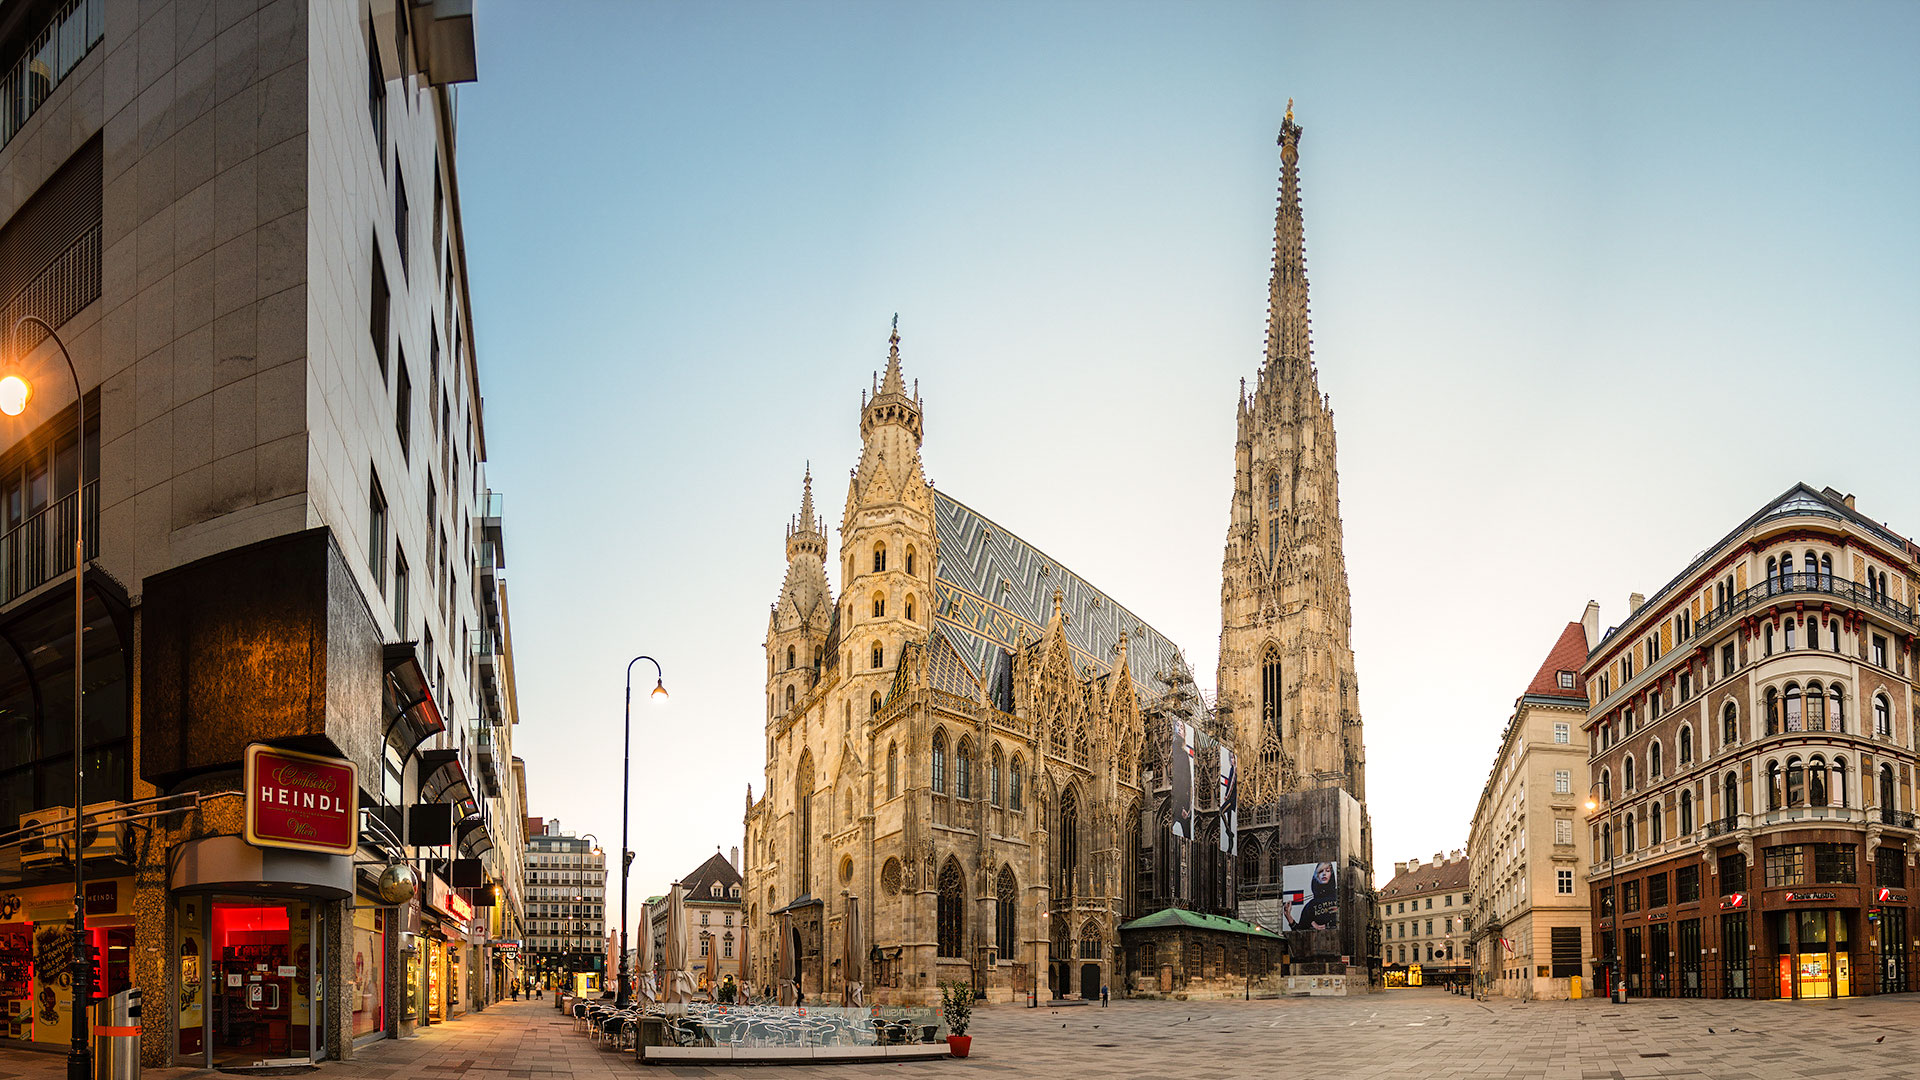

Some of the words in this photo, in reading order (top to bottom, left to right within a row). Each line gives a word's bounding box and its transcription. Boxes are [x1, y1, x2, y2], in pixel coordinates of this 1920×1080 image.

[272, 764, 337, 793] Confiserie
[261, 786, 345, 813] HEINDL
[287, 818, 318, 838] Wien
[1813, 891, 1836, 899] Austria
[1313, 901, 1337, 910] TOMMY
